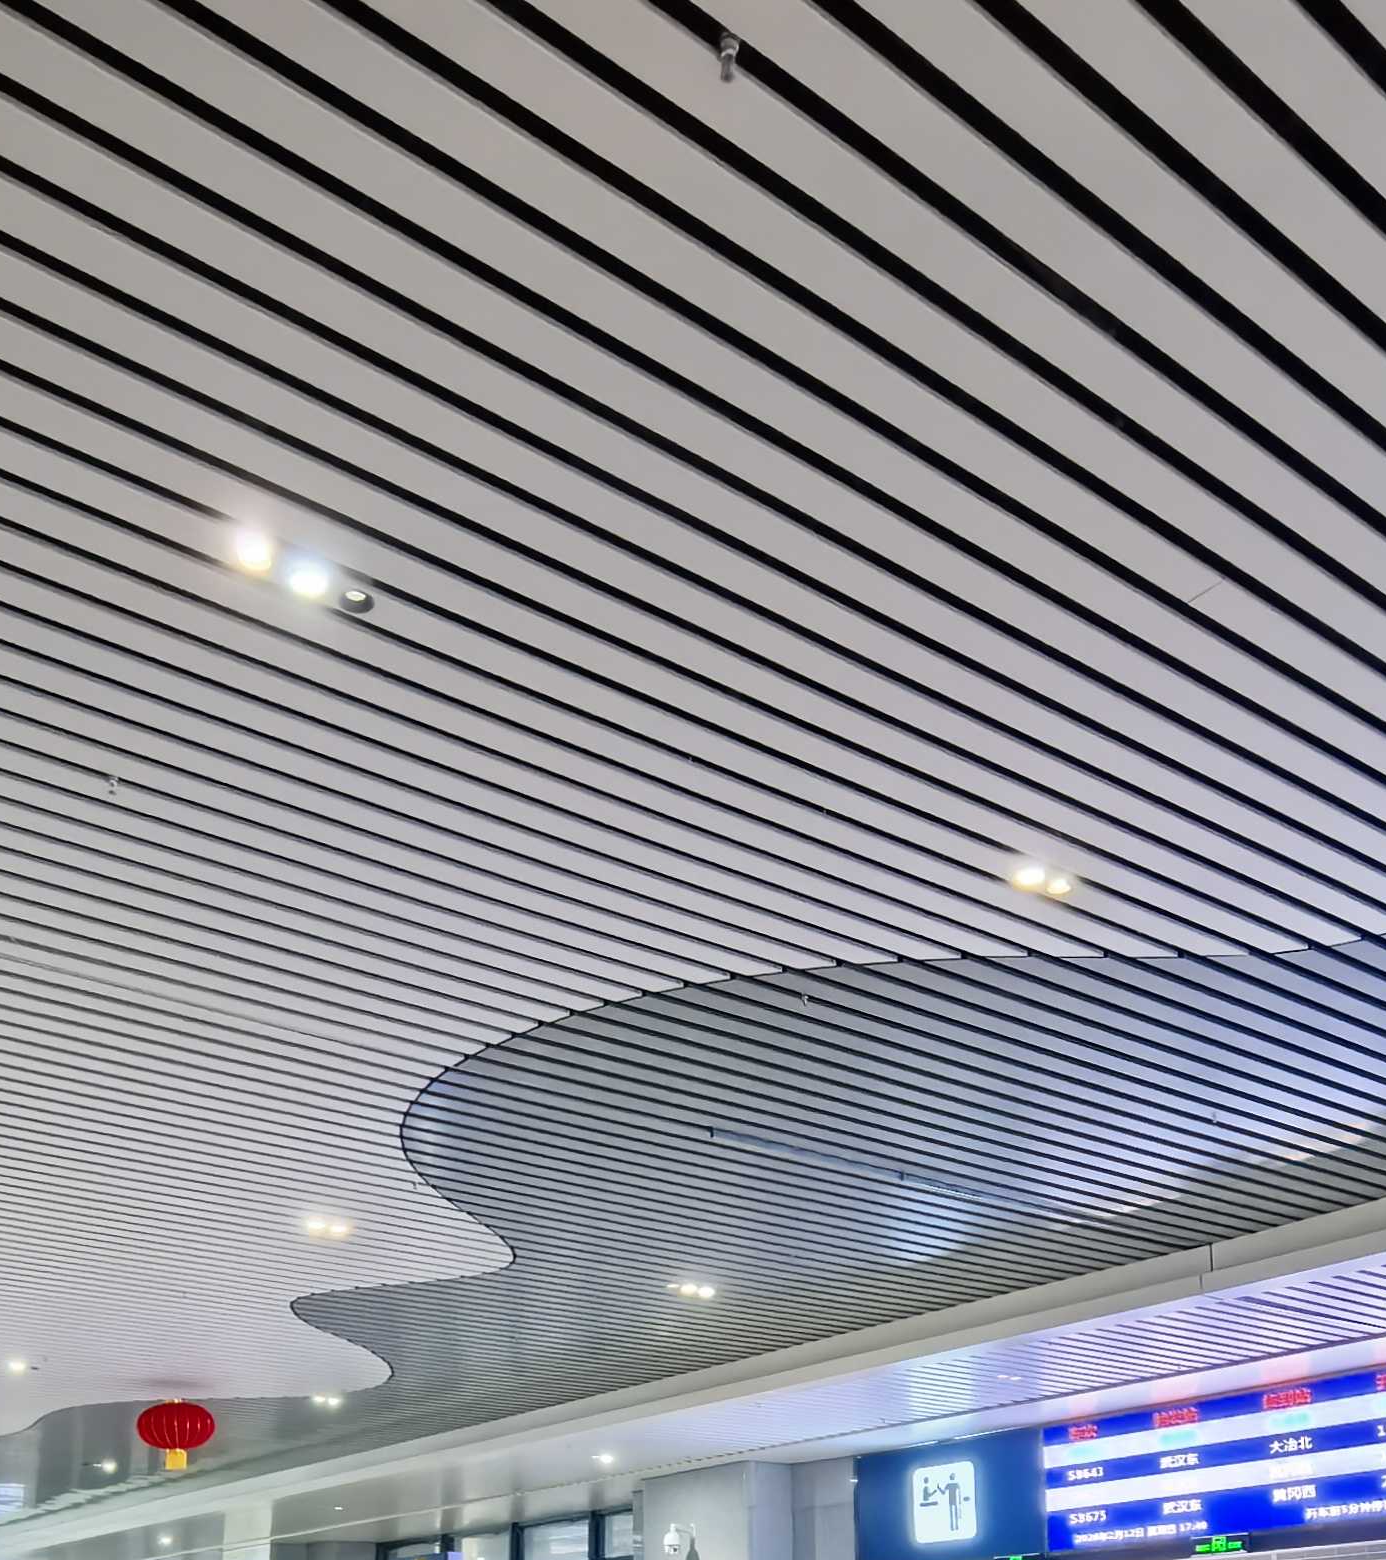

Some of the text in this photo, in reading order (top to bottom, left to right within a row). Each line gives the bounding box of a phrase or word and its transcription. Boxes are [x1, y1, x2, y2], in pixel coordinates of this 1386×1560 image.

[1269, 1436, 1313, 1454] 大冶北
[1272, 1485, 1317, 1504] 黄冈西
